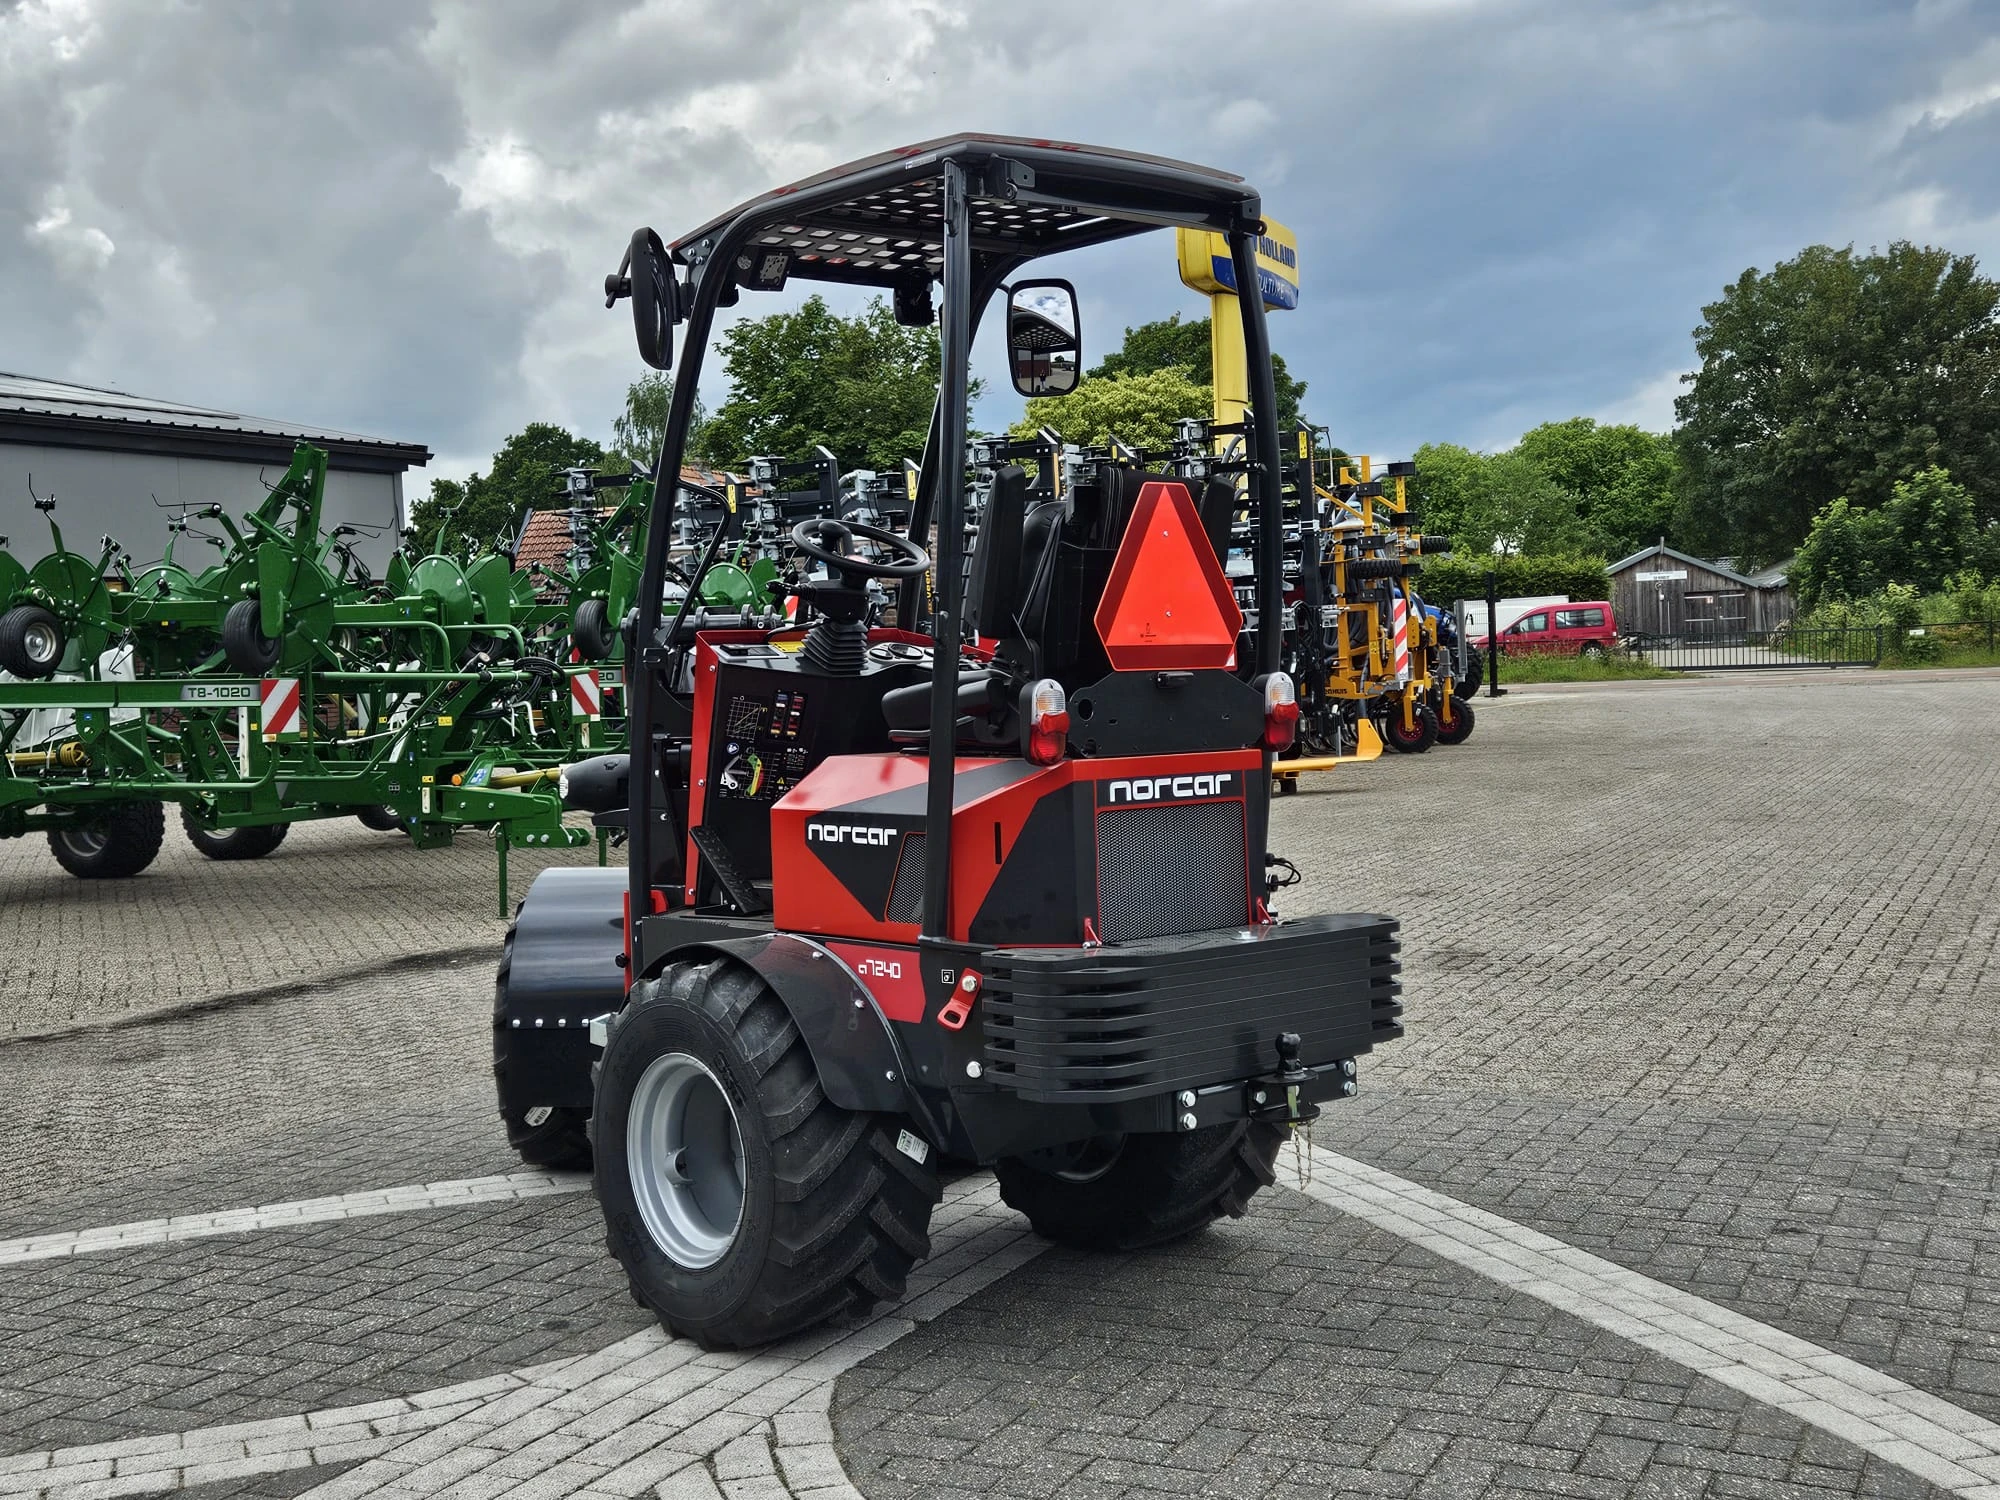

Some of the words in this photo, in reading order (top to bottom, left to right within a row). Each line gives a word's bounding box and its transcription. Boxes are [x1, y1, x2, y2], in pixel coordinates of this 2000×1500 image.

[1259, 236, 1295, 269] HOLLAND
[1109, 774, 1231, 802] norcar
[808, 824, 897, 845] norcar
[858, 959, 901, 979] a7240
